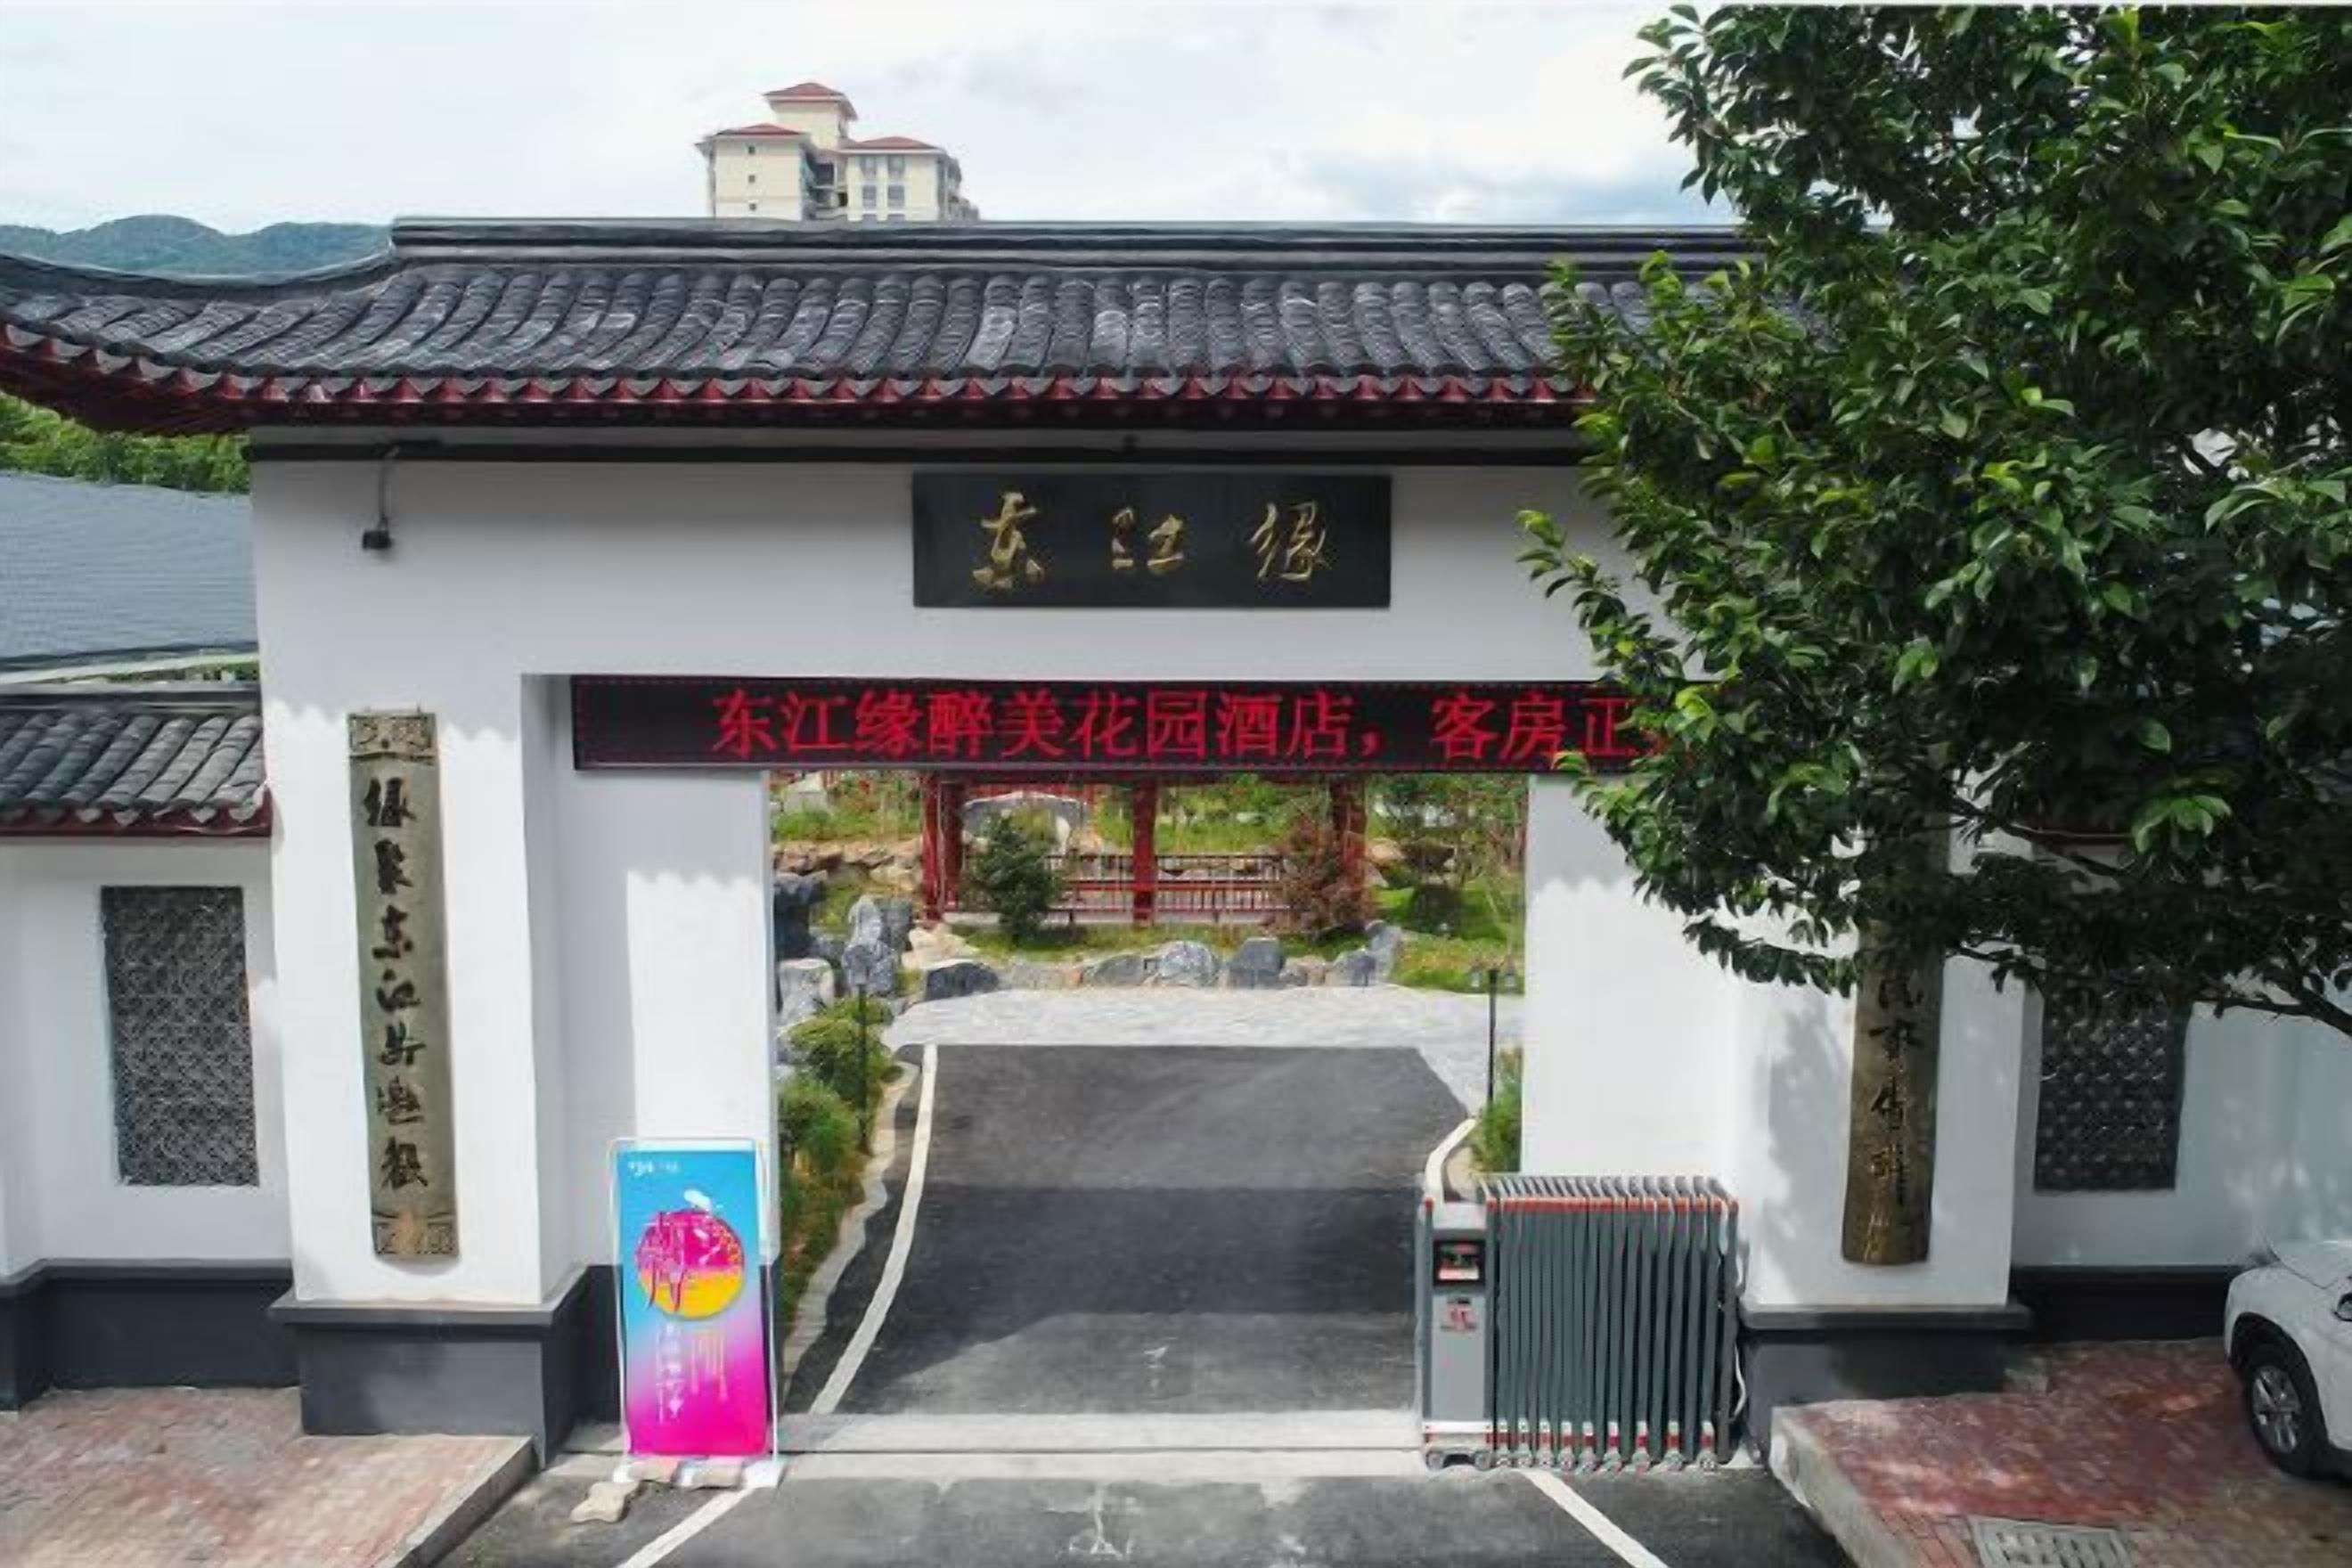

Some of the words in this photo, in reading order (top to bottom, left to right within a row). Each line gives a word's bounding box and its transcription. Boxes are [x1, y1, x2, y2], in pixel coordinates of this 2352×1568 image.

[713, 688, 1668, 760] 东江缘醉美花园酒店，客房正
